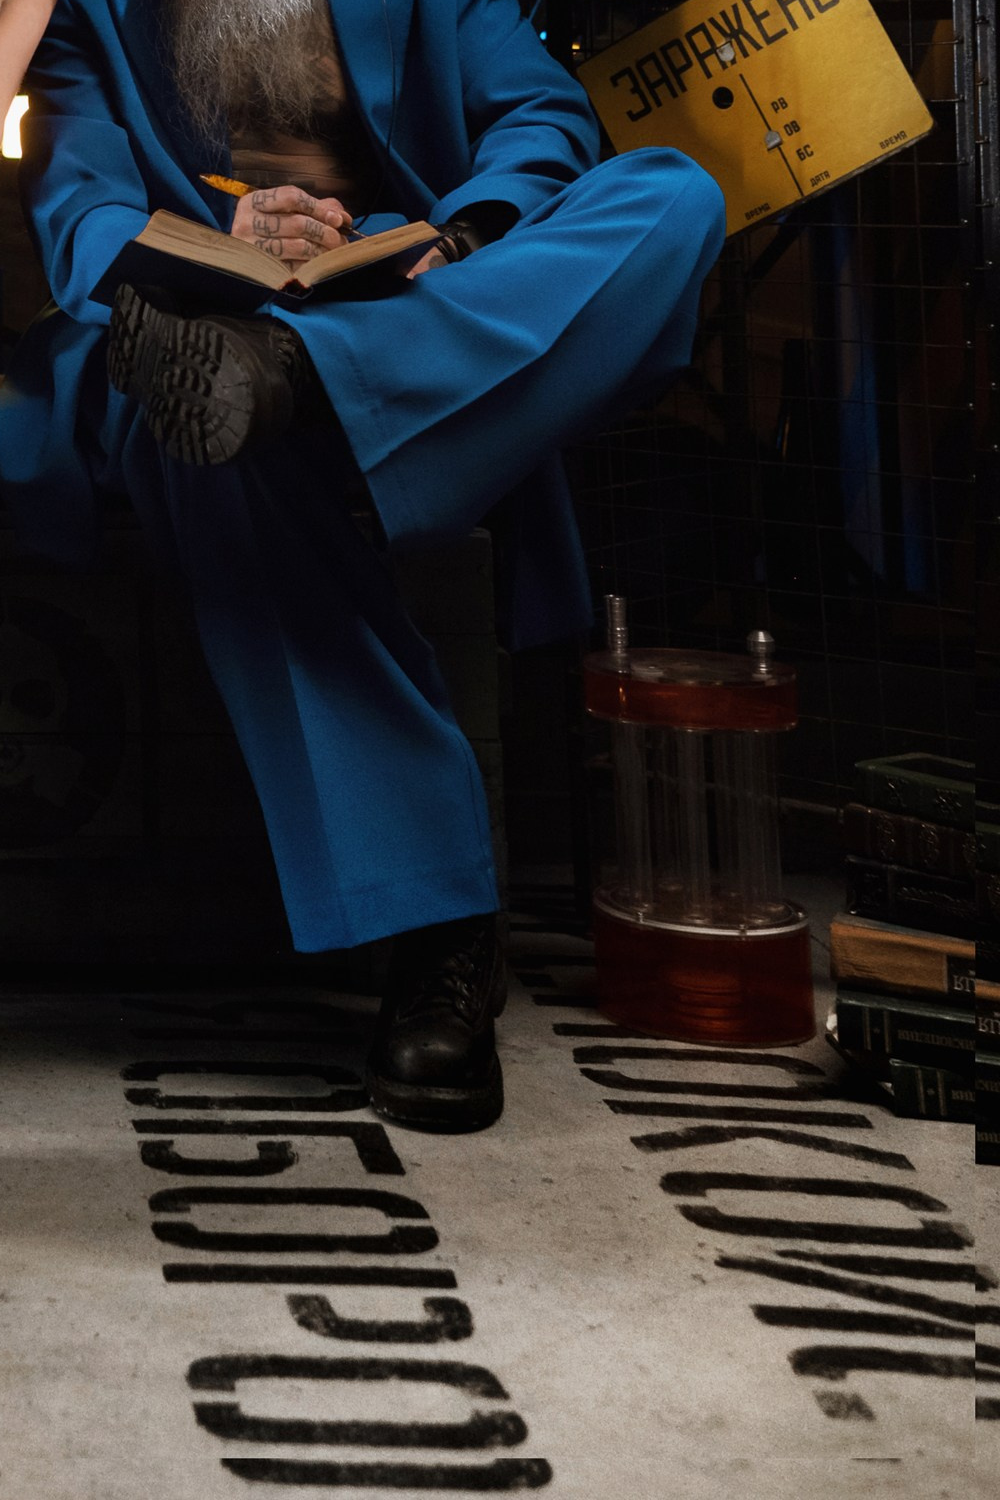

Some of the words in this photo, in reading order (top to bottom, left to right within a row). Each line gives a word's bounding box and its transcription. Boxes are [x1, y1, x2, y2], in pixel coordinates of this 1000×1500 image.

[770, 96, 789, 114] РВ
[783, 120, 802, 137] ОВ
[879, 130, 908, 150] ВРЕМЯ
[796, 144, 814, 162] БС
[809, 170, 831, 188] ДАТА
[744, 203, 772, 221] ВРЕМЯ
